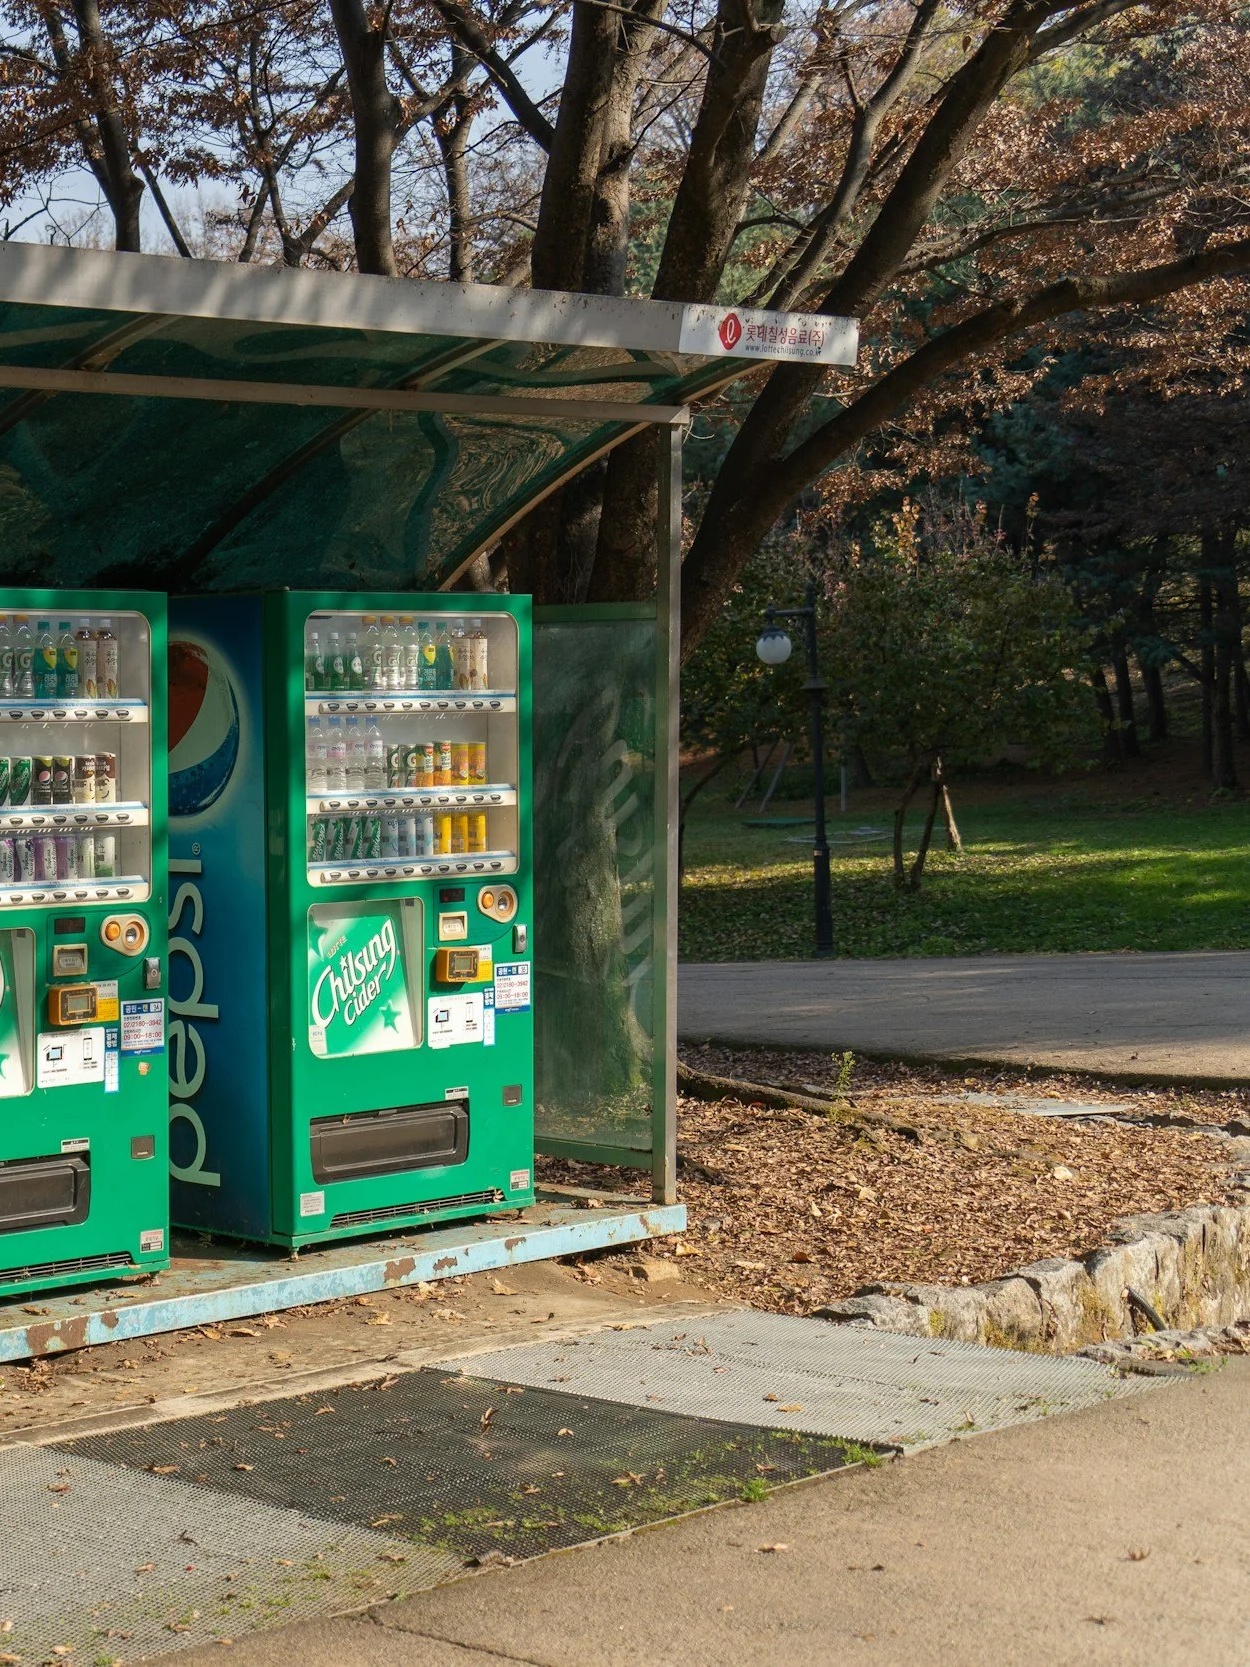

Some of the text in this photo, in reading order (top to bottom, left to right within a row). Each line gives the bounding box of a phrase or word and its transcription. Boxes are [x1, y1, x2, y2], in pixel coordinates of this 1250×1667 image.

[745, 345, 822, 357] www.lottechilsung.co.kr
[746, 325, 825, 347] 롯데칠성음료(주)
[312, 919, 396, 1029] Chilsung
[344, 961, 387, 1026] Cider
